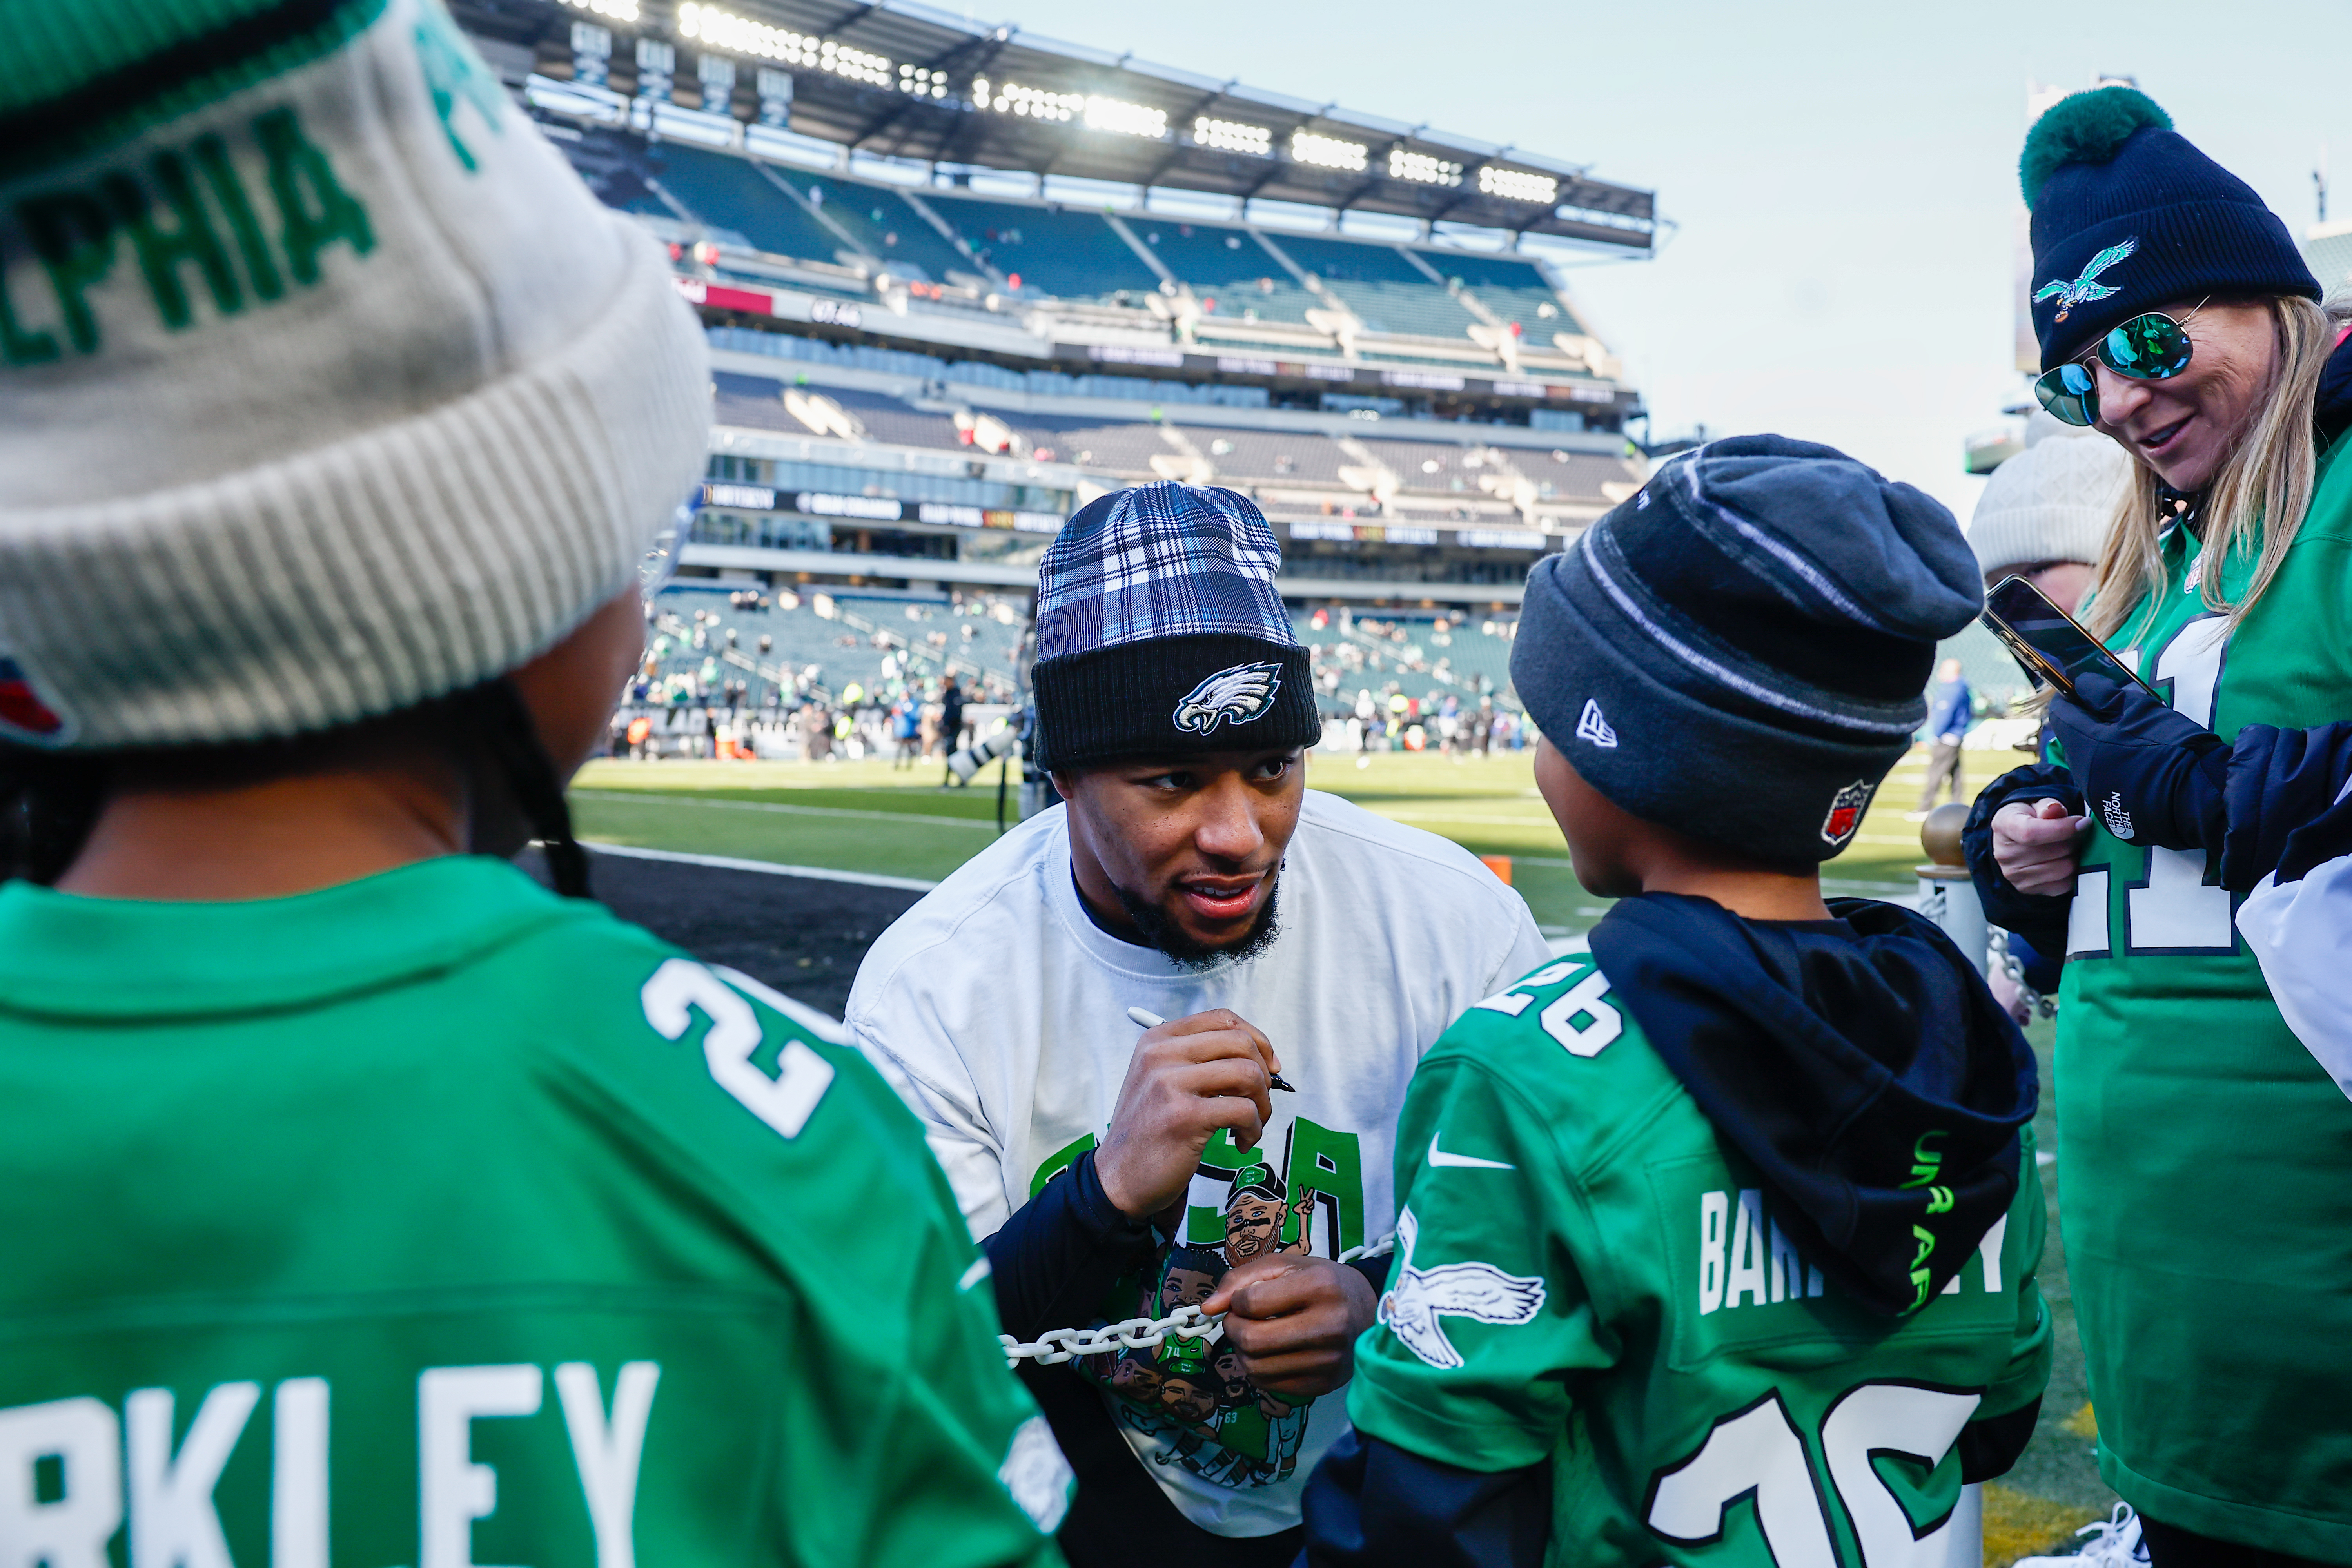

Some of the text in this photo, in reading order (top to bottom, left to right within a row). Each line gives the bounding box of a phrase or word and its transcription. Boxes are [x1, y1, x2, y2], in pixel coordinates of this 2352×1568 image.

[2102, 800, 2115, 825] FACE
[2111, 791, 2124, 827] NORTH
[2121, 811, 2133, 829] THE
[1473, 961, 1623, 1058] 26
[640, 957, 855, 1140] 2
[1167, 1346, 1180, 1358] 74
[1224, 1412, 1238, 1424] 63
